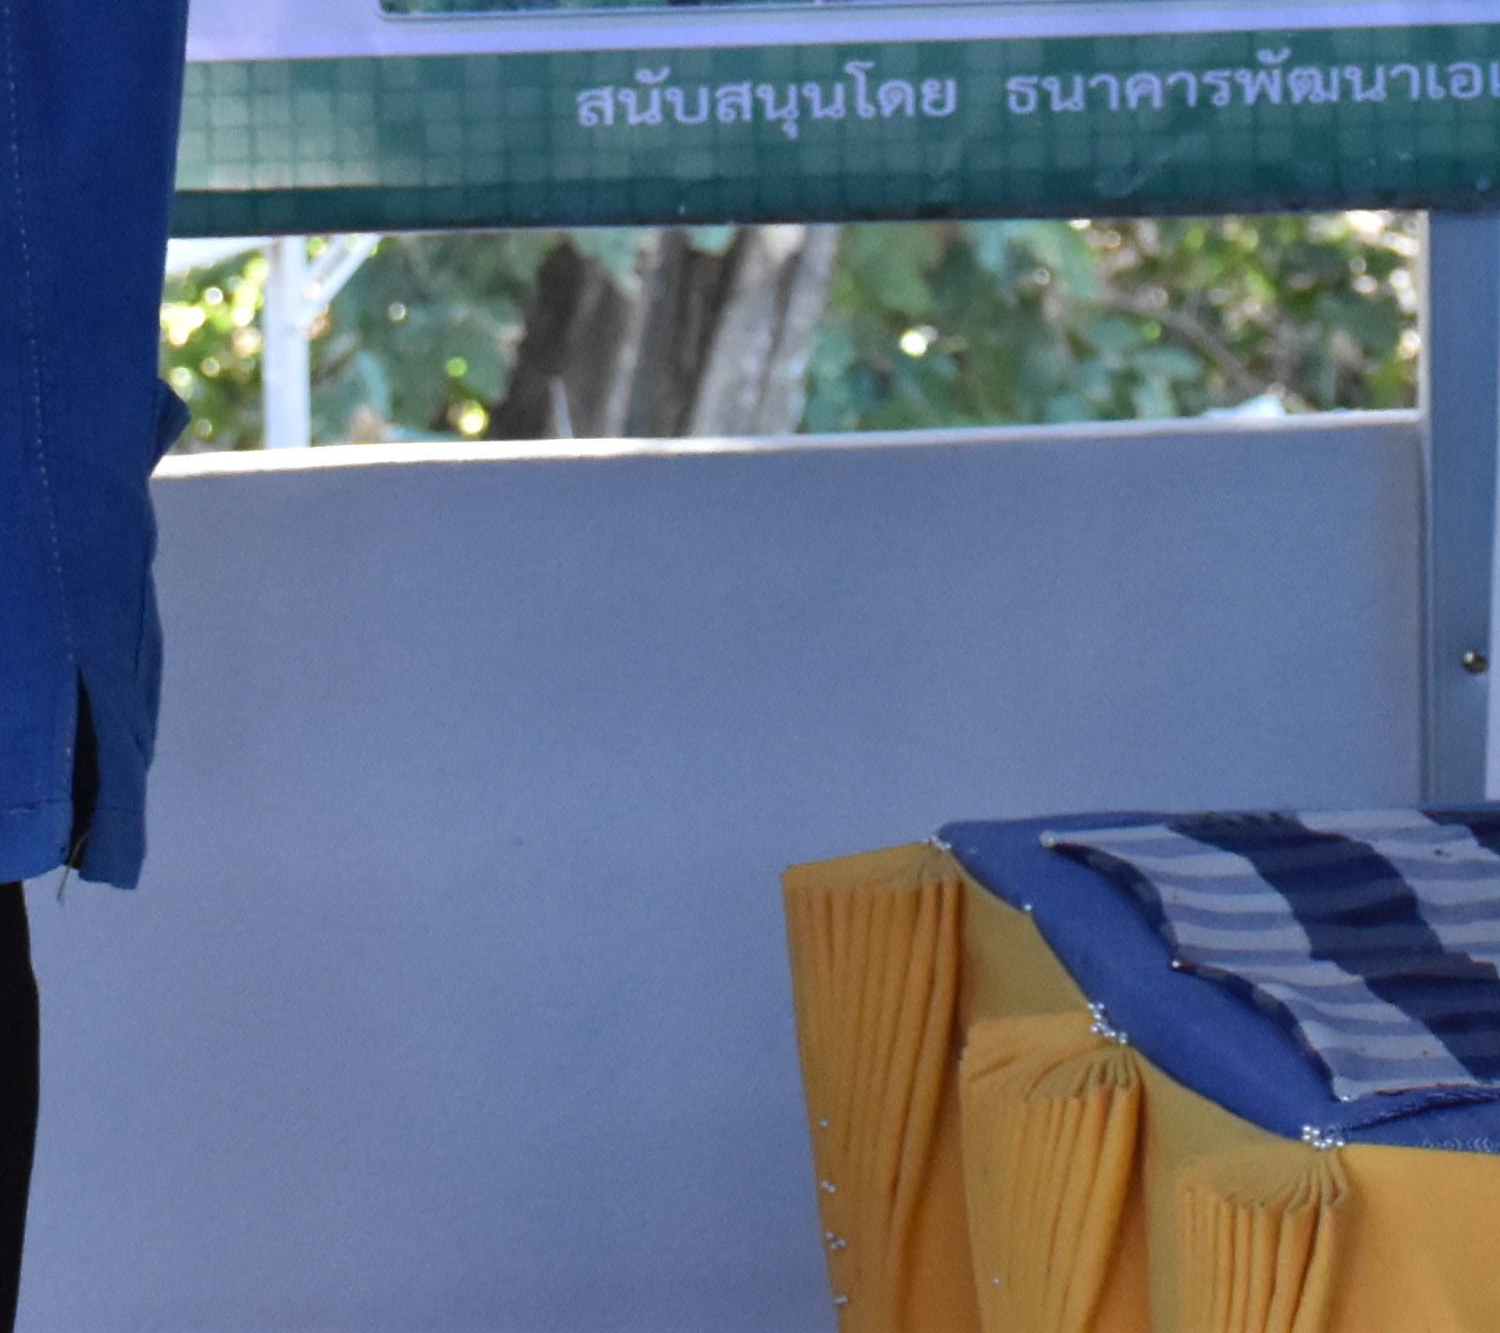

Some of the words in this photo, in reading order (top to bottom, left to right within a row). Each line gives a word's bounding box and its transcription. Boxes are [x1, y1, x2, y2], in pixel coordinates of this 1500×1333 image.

[574, 61, 958, 140] สนับสนุนโดย
